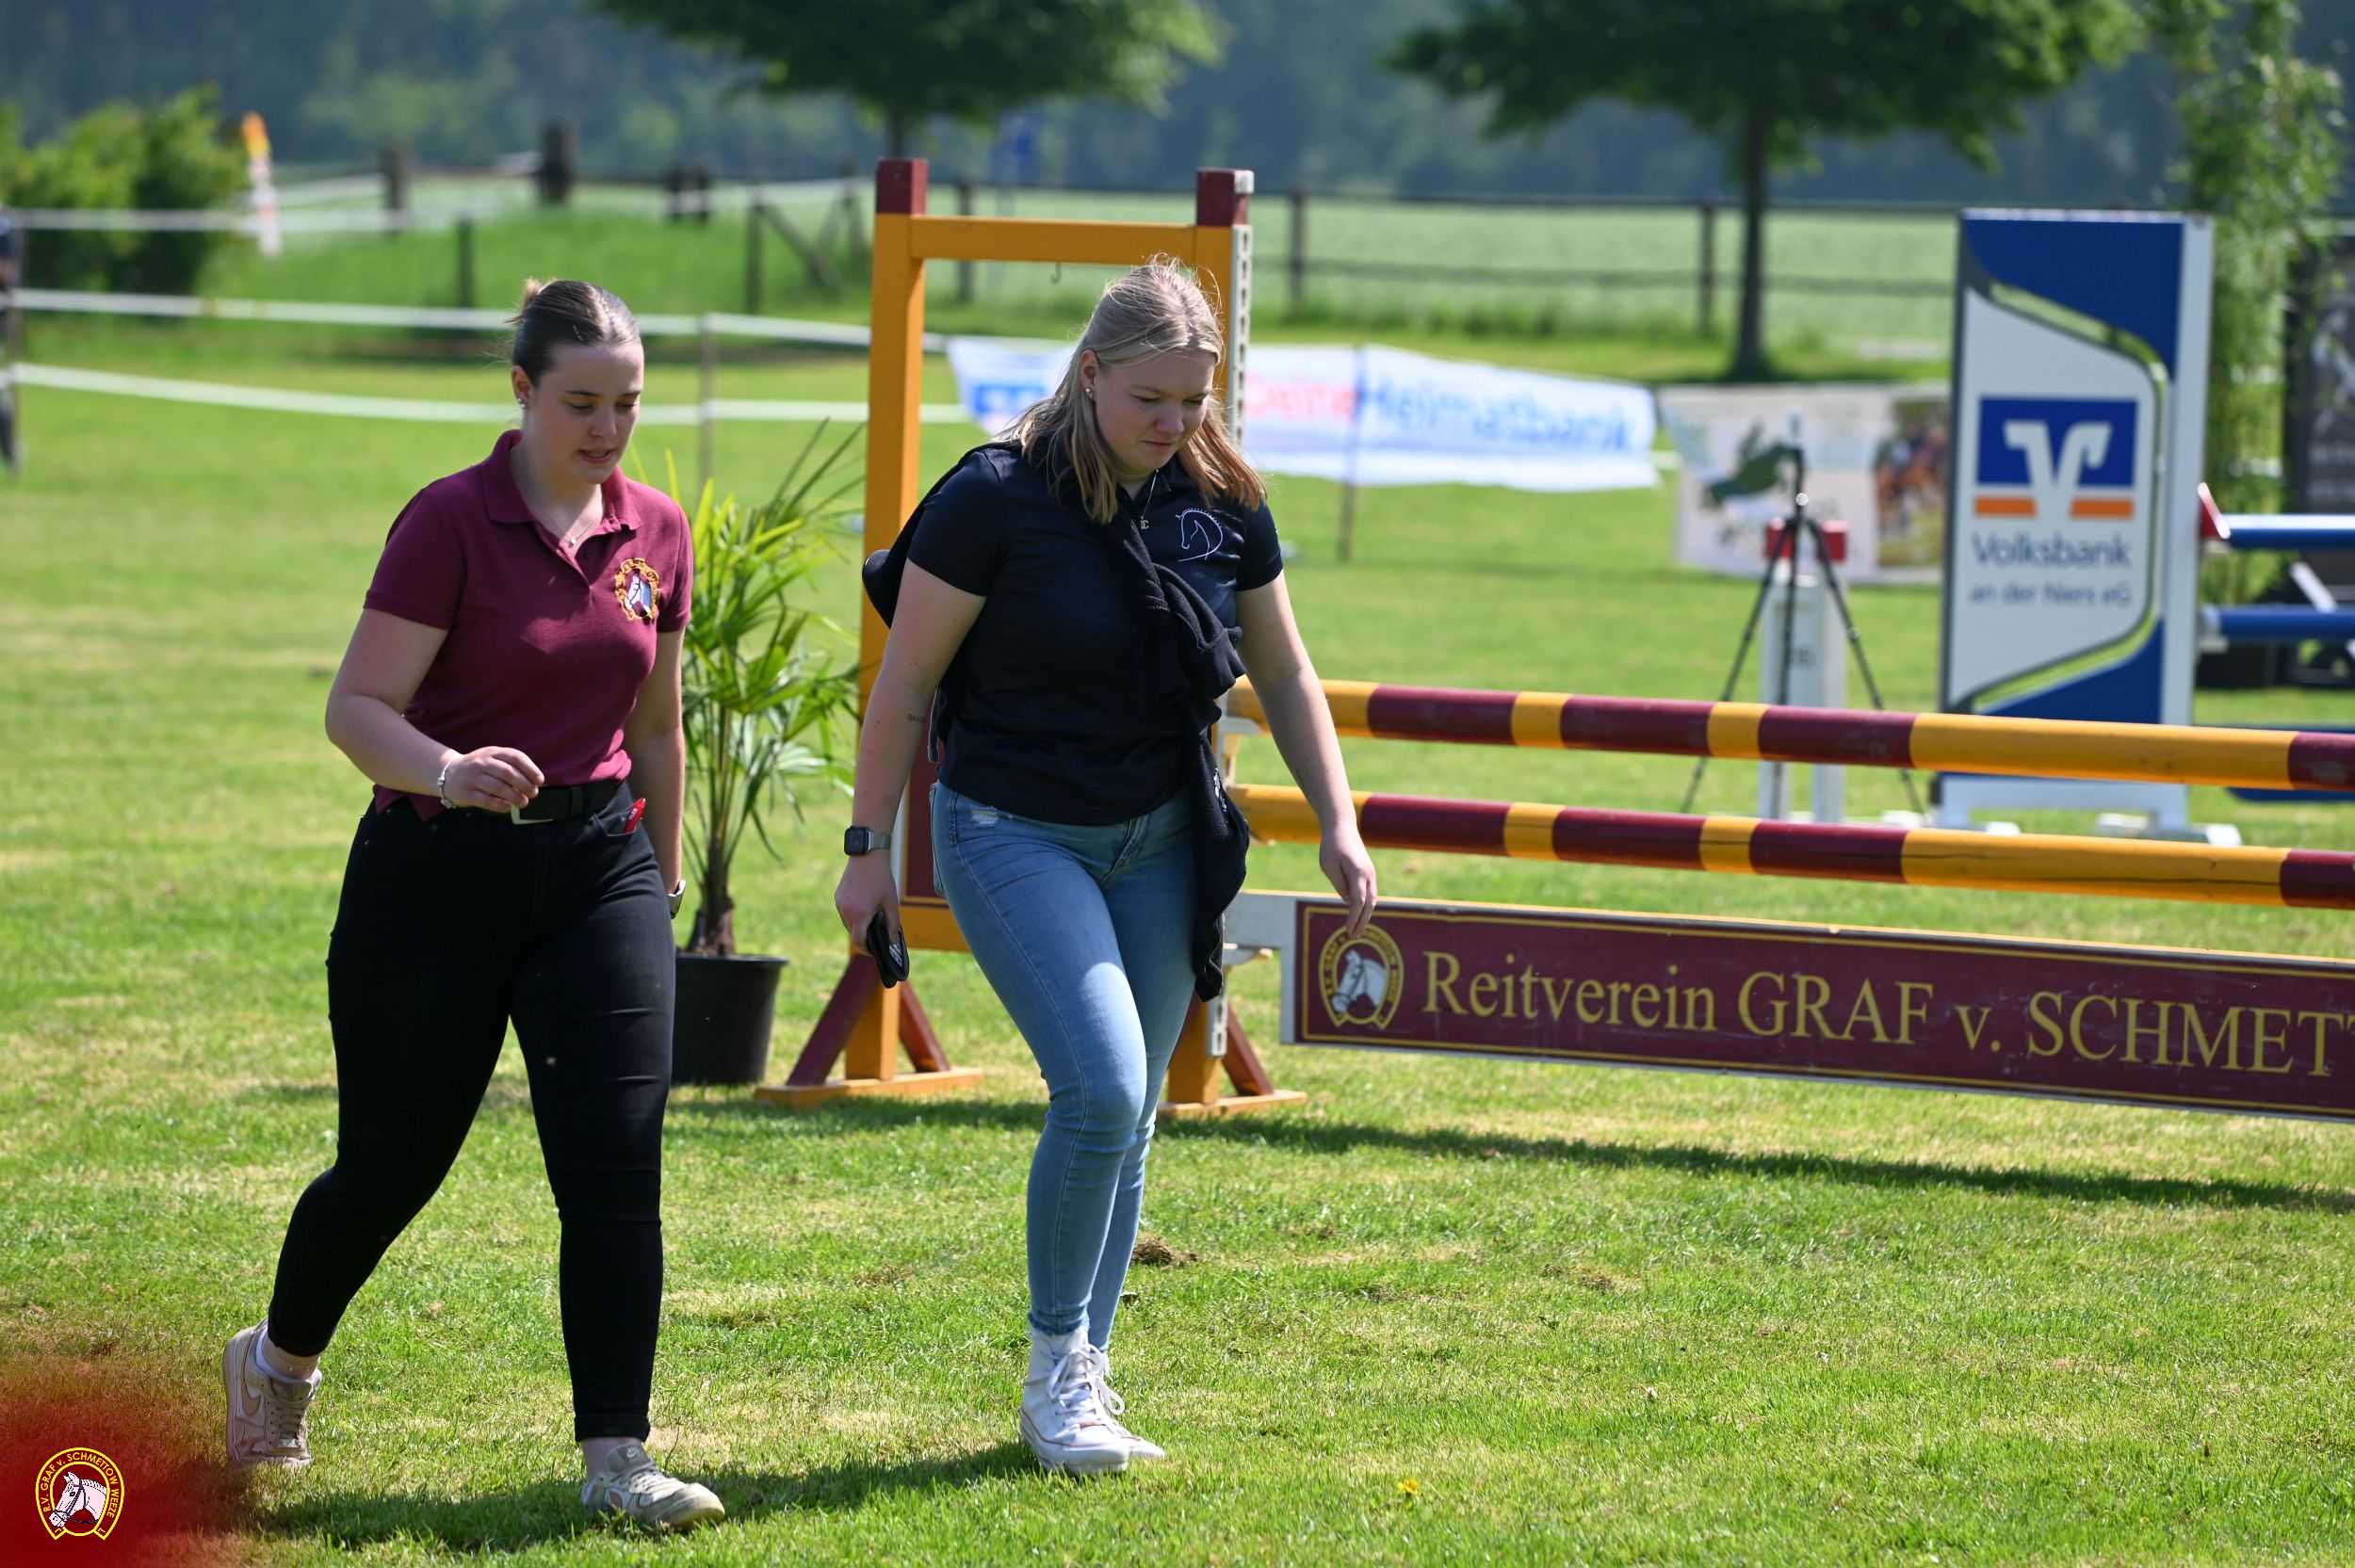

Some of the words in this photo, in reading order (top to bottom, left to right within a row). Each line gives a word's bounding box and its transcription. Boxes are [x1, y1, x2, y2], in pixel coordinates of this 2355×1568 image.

[1356, 368, 1630, 450] Heimatbank
[1973, 532, 2132, 567] Volksbank
[2003, 582, 2035, 603] der
[1422, 951, 1717, 1031] Reitverein
[1738, 971, 1933, 1044] GRAF
[1955, 1005, 2002, 1052] v.
[2028, 991, 2355, 1077] SCHMET
